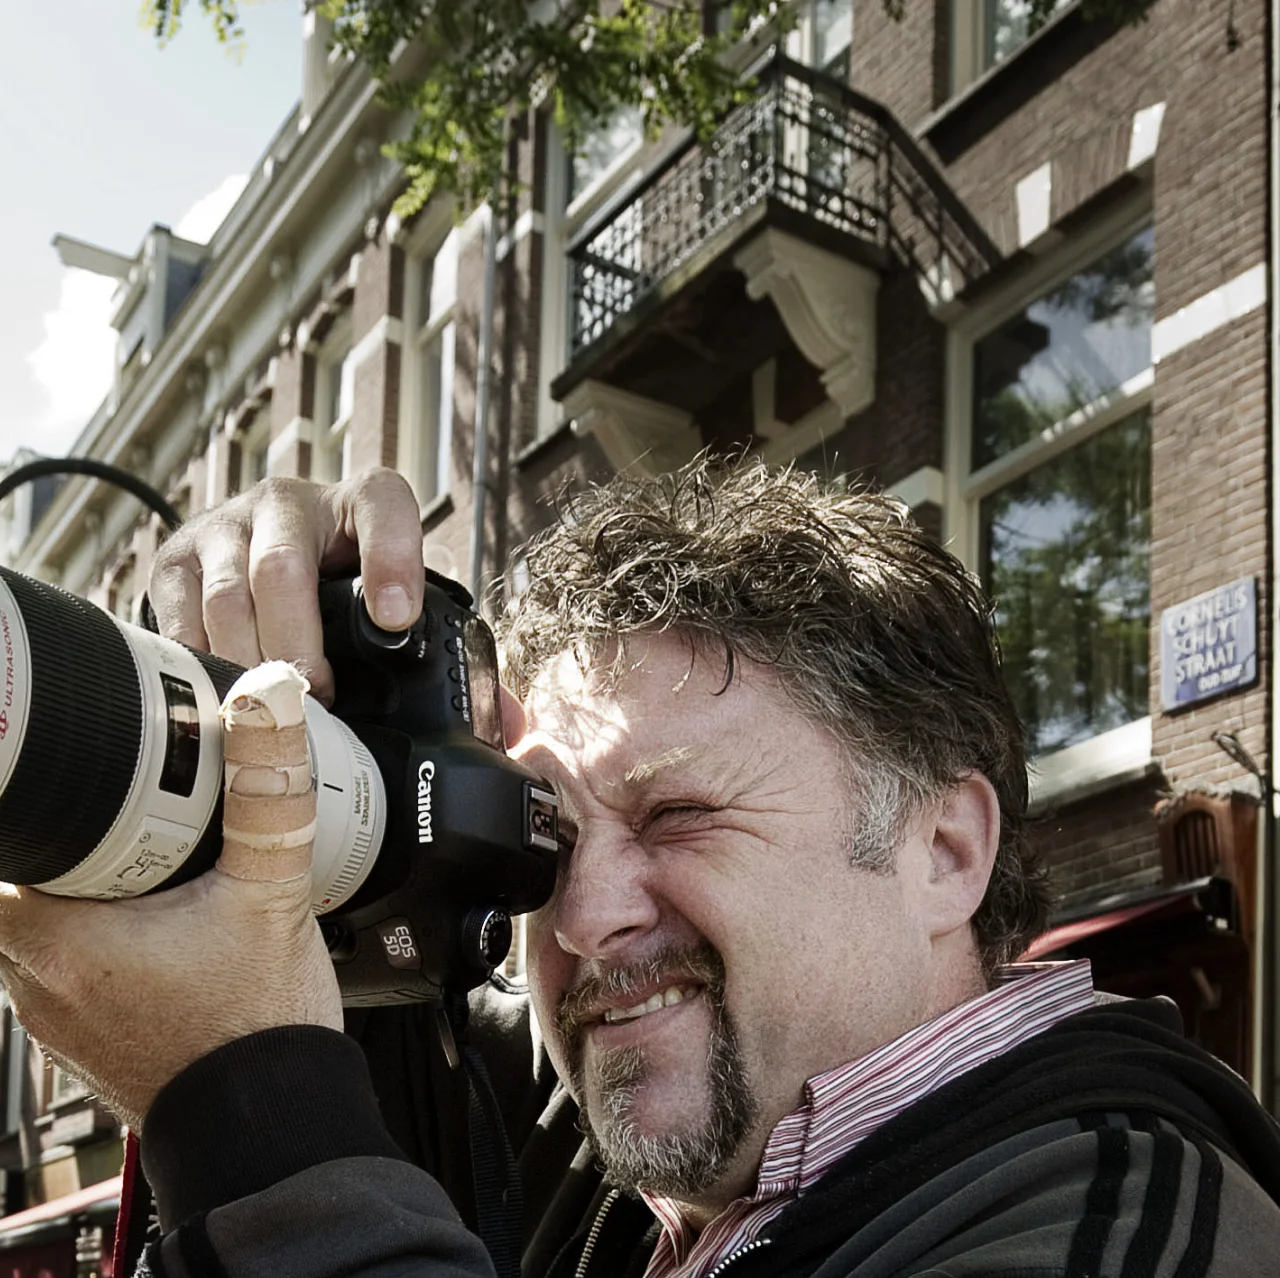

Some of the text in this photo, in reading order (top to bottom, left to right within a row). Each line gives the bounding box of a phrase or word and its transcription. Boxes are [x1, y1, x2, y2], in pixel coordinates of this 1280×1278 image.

[1175, 641, 1237, 684] STRAAT
[418, 760, 435, 844] Canon
[383, 935, 401, 956] 5D
[395, 925, 417, 958] EOS
